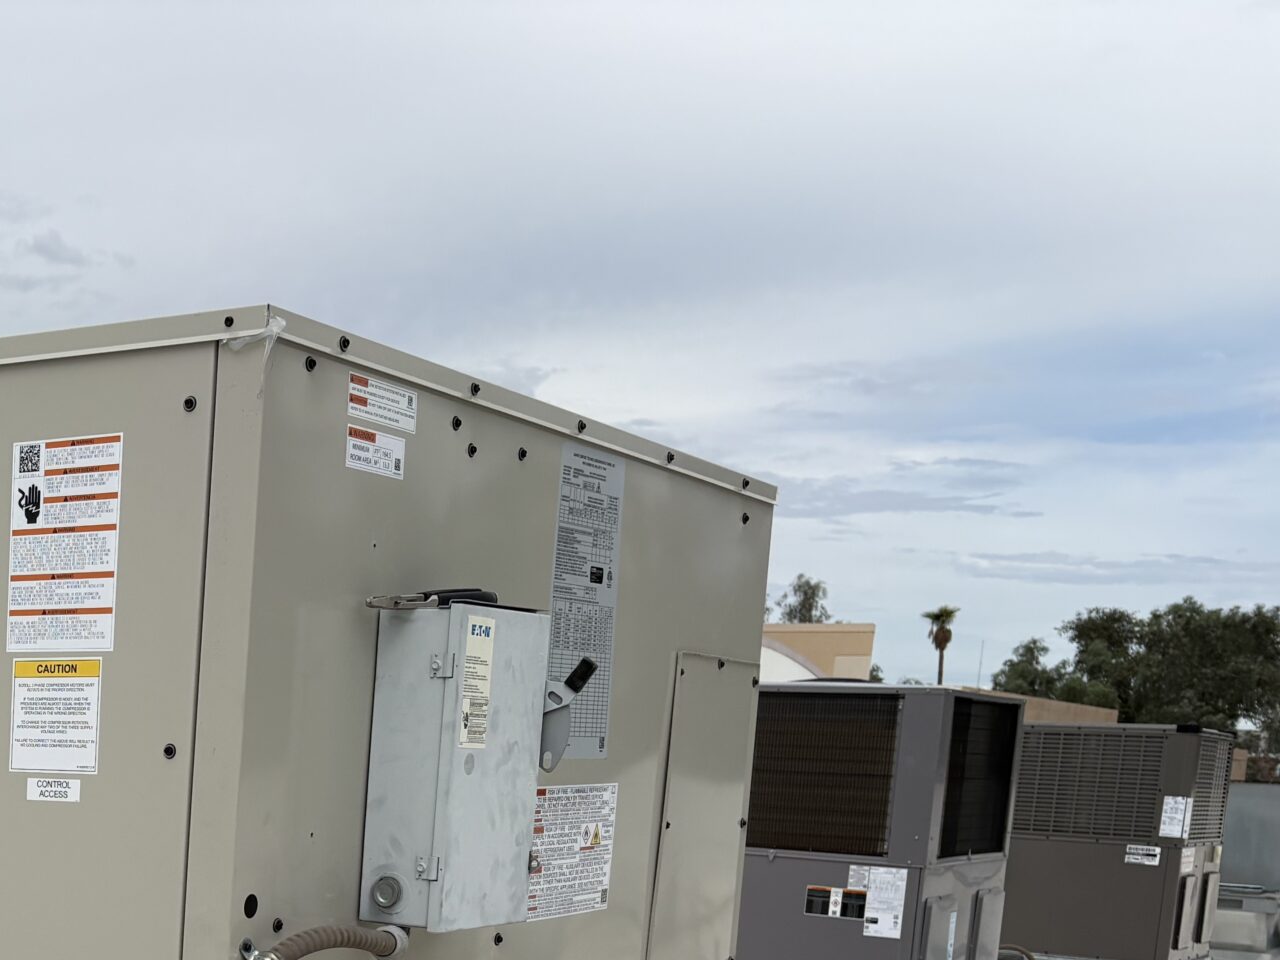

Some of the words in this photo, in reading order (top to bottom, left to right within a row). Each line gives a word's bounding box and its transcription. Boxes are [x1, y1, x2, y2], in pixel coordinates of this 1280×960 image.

[472, 624, 491, 638] EATON
[36, 664, 77, 674] CAUTION
[36, 780, 71, 789] CONTROL
[39, 790, 68, 799] ACCESS
